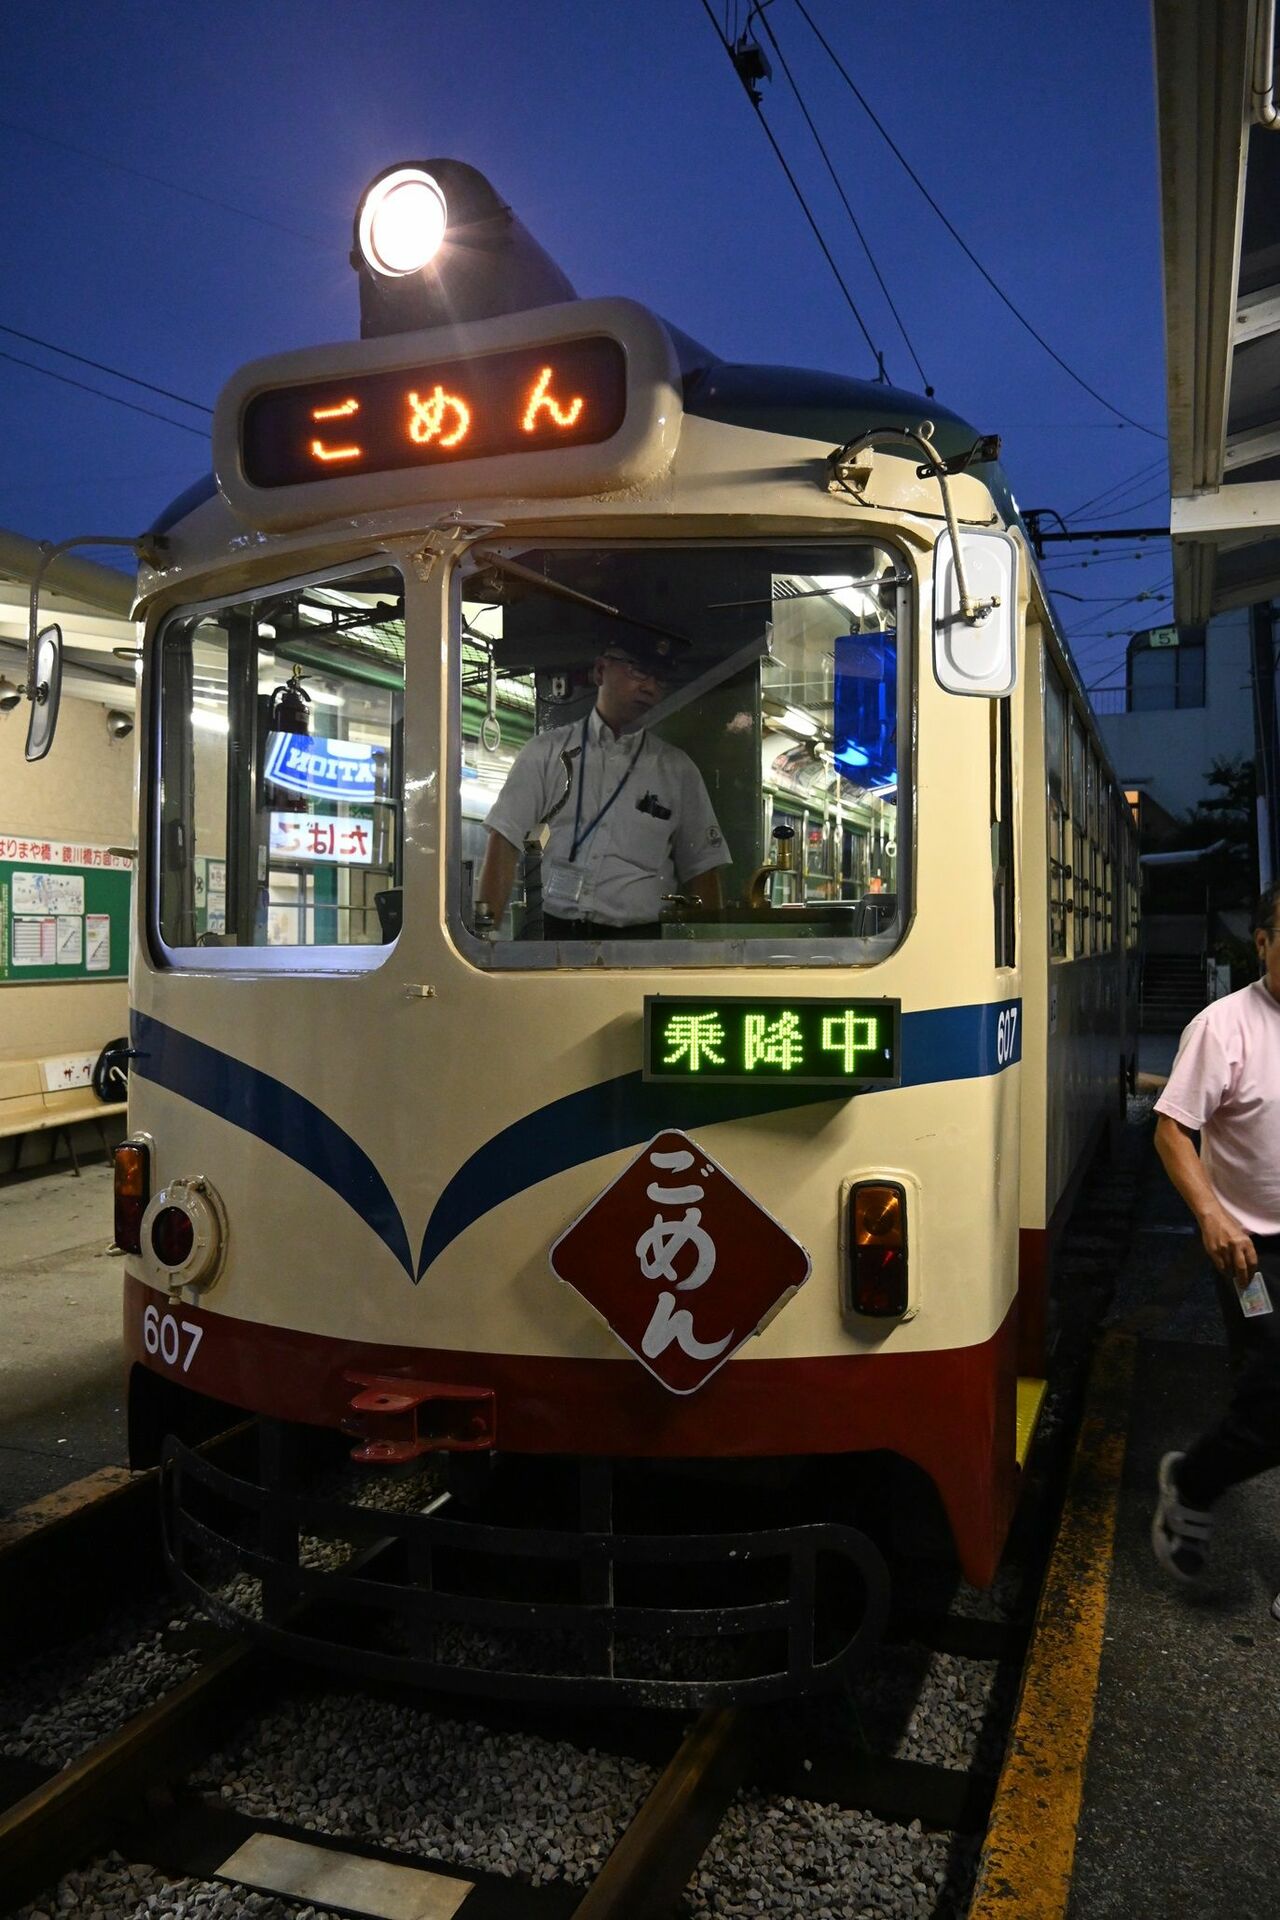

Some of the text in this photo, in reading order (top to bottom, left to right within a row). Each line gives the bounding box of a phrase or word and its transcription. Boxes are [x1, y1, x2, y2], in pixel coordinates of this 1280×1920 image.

[663, 1010, 878, 1074] 乗降中
[996, 1006, 1018, 1066] 607
[635, 1150, 735, 1360] ごめん
[143, 1304, 204, 1373] 607
